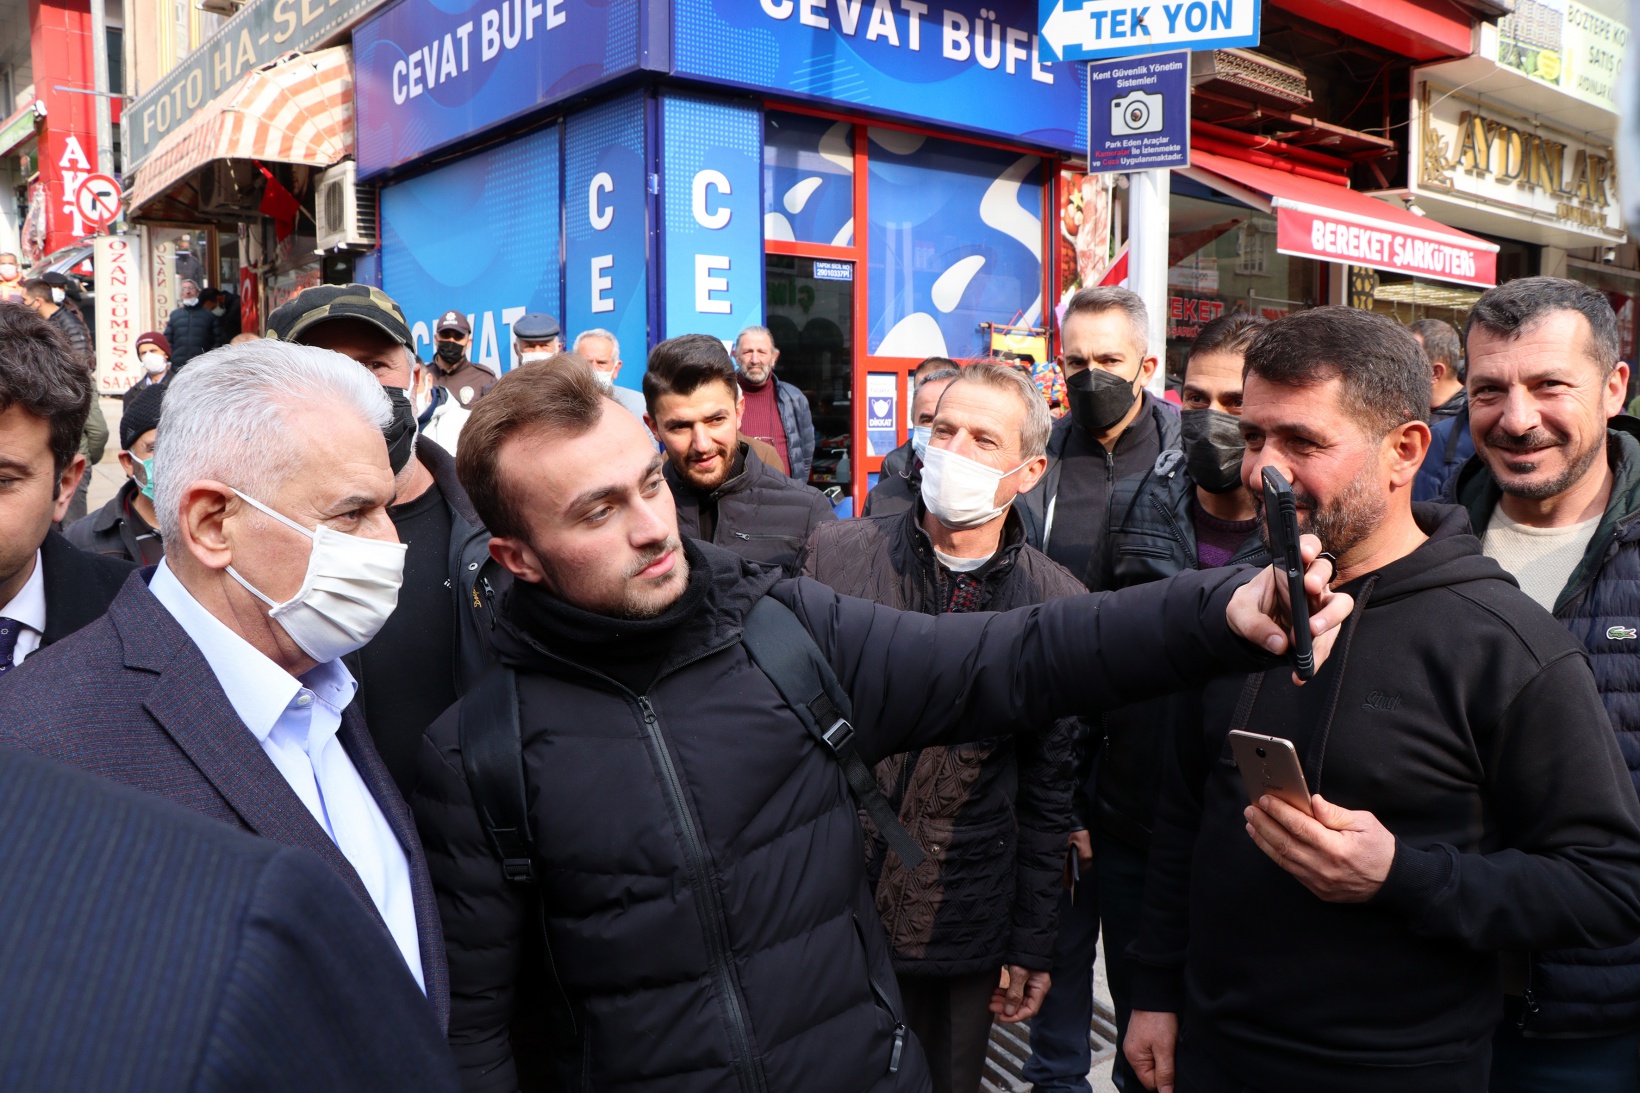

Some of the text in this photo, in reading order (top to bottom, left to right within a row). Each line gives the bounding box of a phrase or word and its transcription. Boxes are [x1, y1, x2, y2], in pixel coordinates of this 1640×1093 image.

[1090, 6, 1152, 40] TEK
[392, 20, 474, 106] CEVAT
[942, 8, 1055, 86] BÜFE
[1092, 61, 1183, 81] Kent Güvenlik Yönetim
[1116, 75, 1157, 88] Sistemleri
[143, 67, 203, 144] FOTO
[1094, 148, 1130, 157] Kameralar
[1105, 136, 1170, 149] Park Eden Araçlar
[1453, 110, 1611, 208] AYDINLAR
[1101, 158, 1119, 166] Ceza
[108, 240, 128, 286] OZAN
[1311, 219, 1476, 278] BEREKET ŞARKÜTERİ
[109, 292, 130, 358] GÜMÜŞ
[1166, 296, 1224, 323] EKET
[102, 376, 140, 389] SAAT
